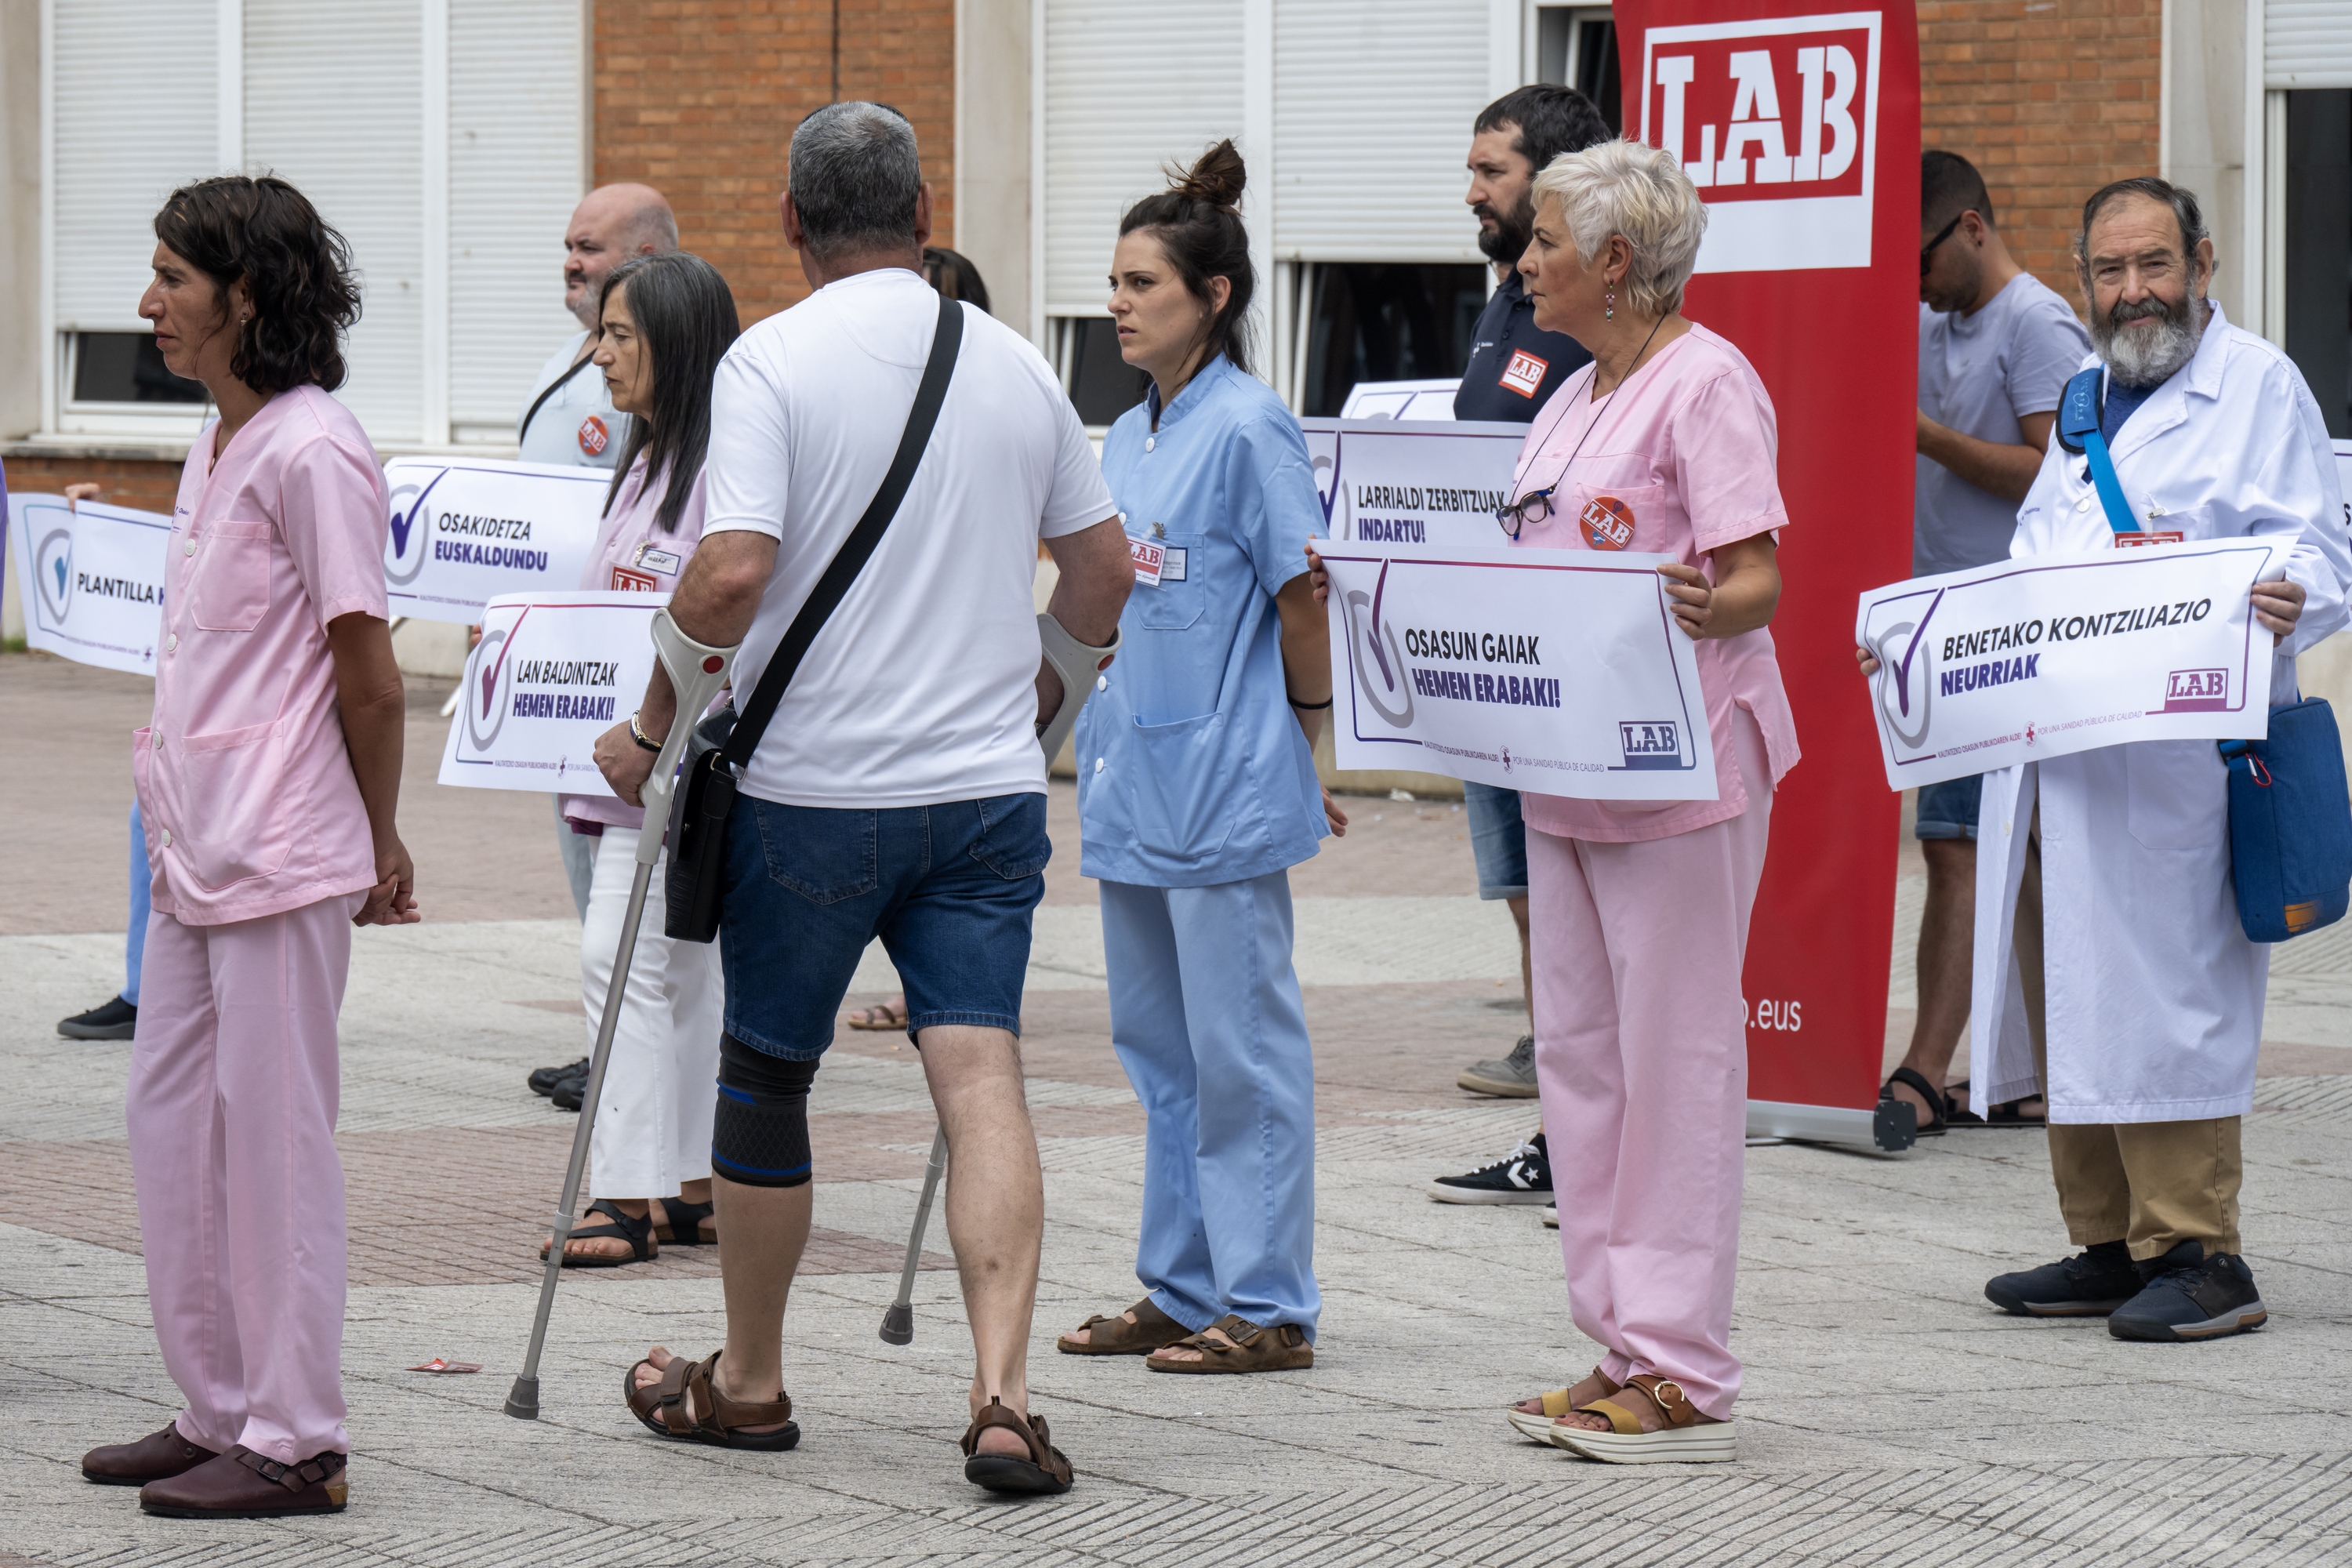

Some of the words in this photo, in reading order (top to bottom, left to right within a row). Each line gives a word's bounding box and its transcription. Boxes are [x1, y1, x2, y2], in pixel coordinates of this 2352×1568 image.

[1657, 45, 1857, 187] LAB
[1509, 358, 1541, 383] LAB
[581, 420, 604, 449] LAB
[1359, 485, 1425, 510] LARRIALDI
[1426, 488, 1504, 514] ZERBITZUAK
[439, 512, 531, 541] OSAKIDETZA
[1359, 518, 1425, 543] INDARTU!
[1584, 503, 1630, 543] LAB
[435, 540, 547, 572] EUSKALDUNDU
[78, 573, 154, 604] PLANTILLA
[1943, 619, 2044, 662] BENETAKO
[2048, 598, 2212, 642] KONTZILIAZIO
[1405, 628, 1478, 661] OSASUN
[1482, 633, 1541, 665] GAIAK
[517, 660, 543, 684] LAN
[542, 661, 619, 686] BALDINTZAK
[1940, 653, 2041, 697] NEURRIAK
[2169, 673, 2223, 698] LAB
[1411, 668, 1472, 701] HEMEN
[1473, 673, 1560, 709] ERABAKI!
[513, 693, 554, 718] HEMEN
[556, 695, 615, 721] ERABAKI!
[2038, 727, 2048, 735] POR
[2049, 724, 2060, 734] UNA
[2061, 720, 2084, 731] SANIDAD
[2116, 710, 2143, 721] CALIDAD
[1623, 726, 1675, 752] LAB
[1533, 758, 1554, 768] SANIDAD
[1573, 763, 1579, 771] DE
[1580, 763, 1605, 772] CALIDAD
